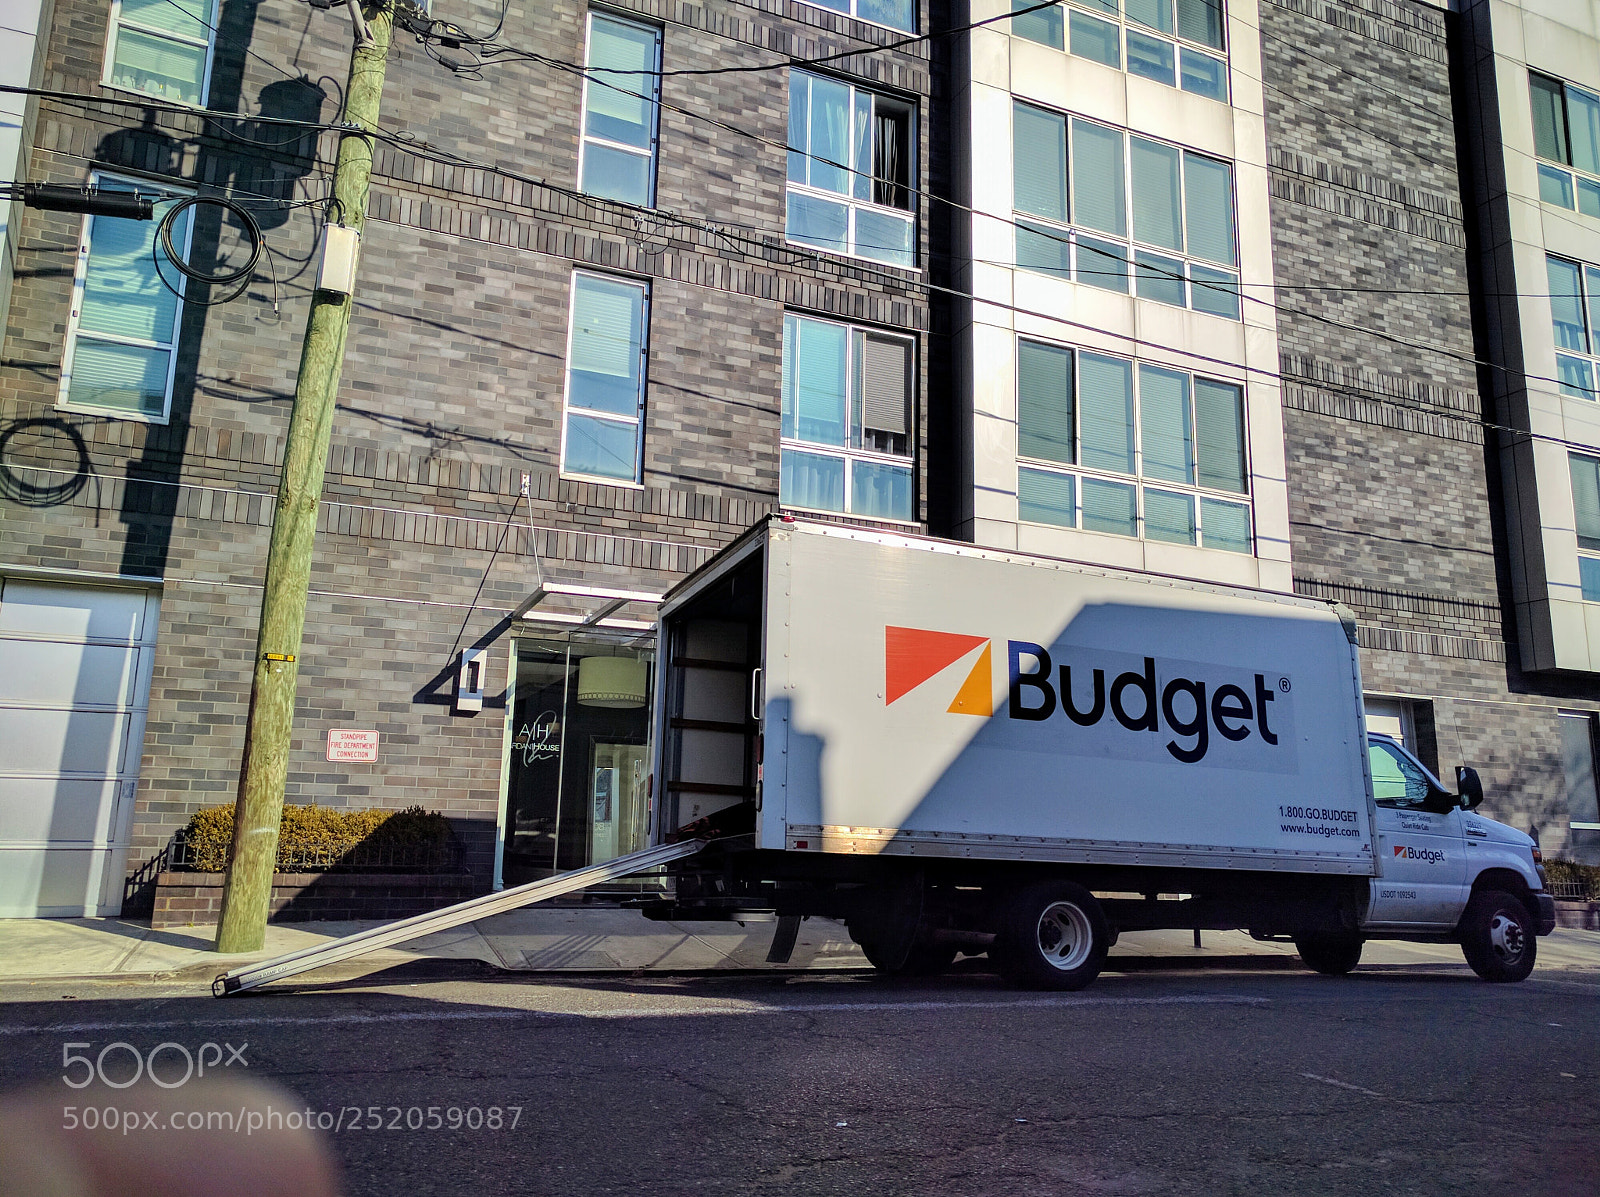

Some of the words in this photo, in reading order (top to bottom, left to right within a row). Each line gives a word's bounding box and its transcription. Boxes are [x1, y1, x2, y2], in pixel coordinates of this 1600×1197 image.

[1008, 640, 1278, 763] Budget
[1279, 806, 1357, 822] 1.800.GO.BUDGET
[1281, 823, 1360, 838] www.budget.com
[1408, 847, 1445, 864] Budget
[1381, 890, 1396, 898] USDOT
